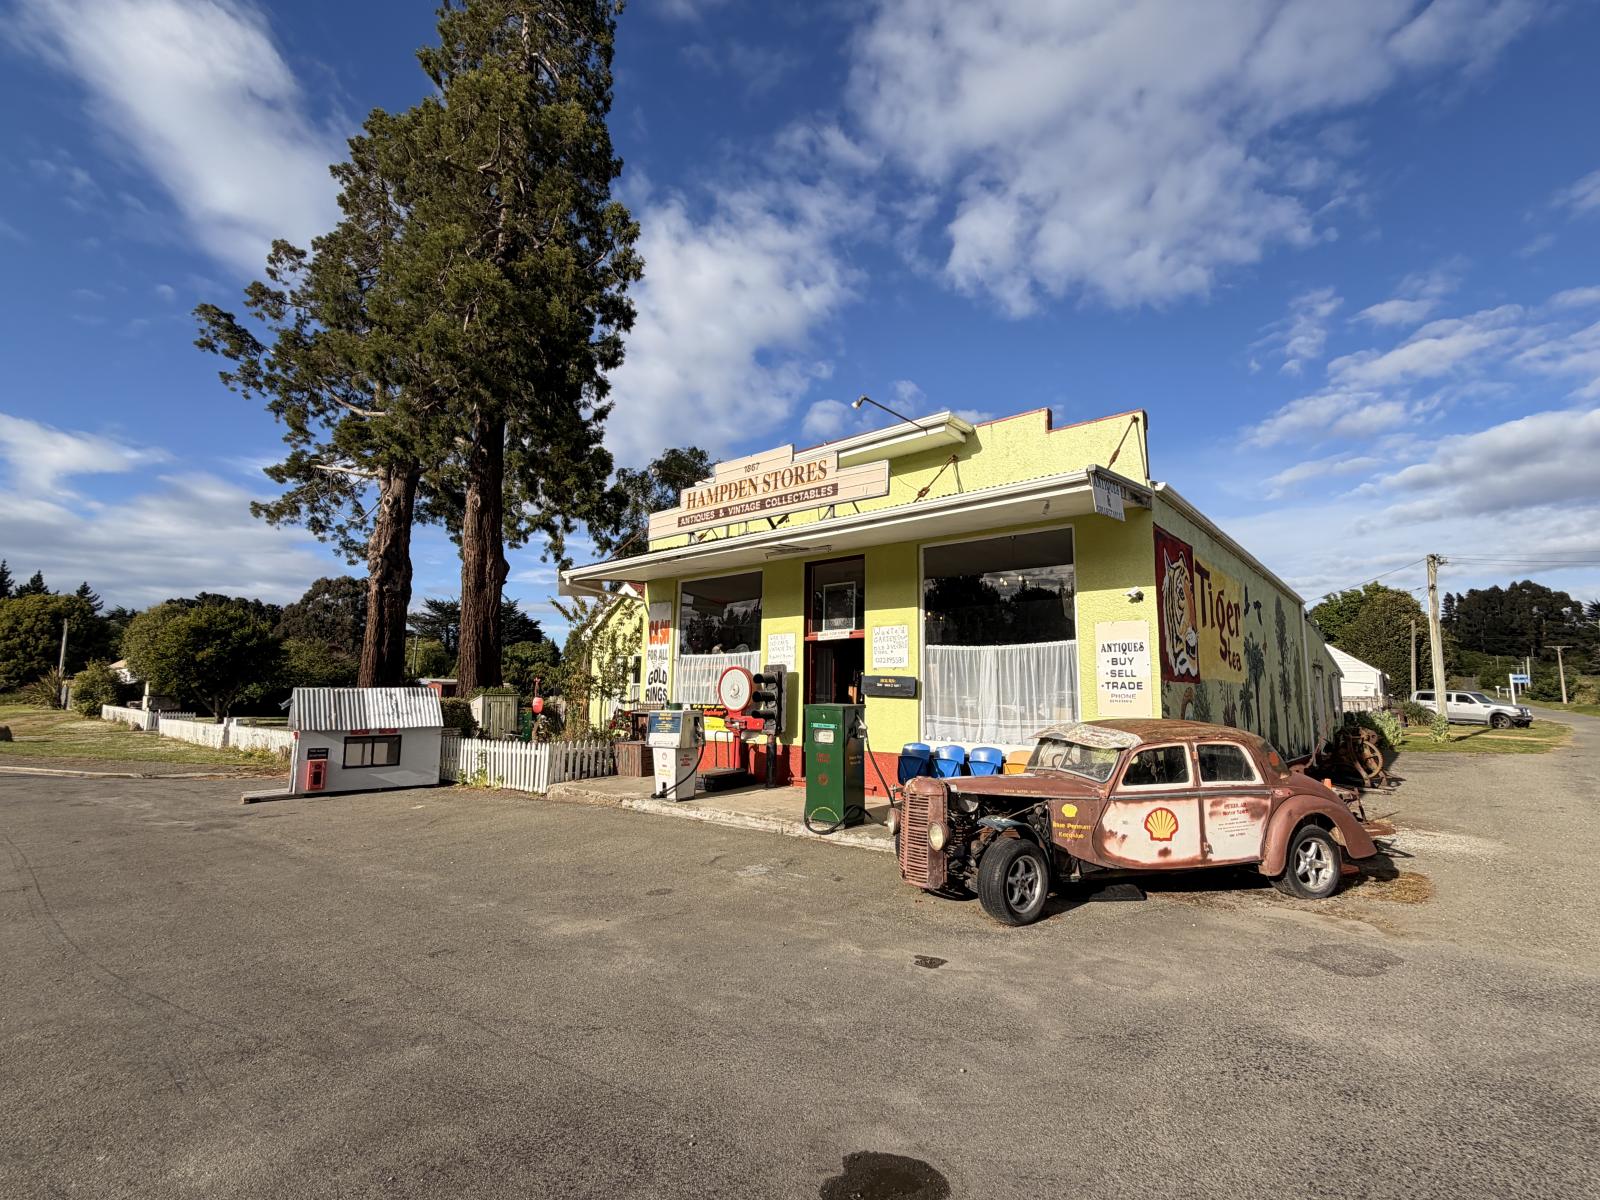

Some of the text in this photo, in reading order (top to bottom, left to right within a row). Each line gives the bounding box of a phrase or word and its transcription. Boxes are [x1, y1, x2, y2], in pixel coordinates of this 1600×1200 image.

[686, 460, 828, 510] HAMPDEN STORES
[680, 486, 834, 526] ANTIQUES & VINTAGE COLLECTABLES
[1195, 559, 1240, 661] Tiger
[648, 648, 668, 661] FOR ALL
[1101, 642, 1145, 655] ANTIQUES
[1111, 657, 1135, 666] BUY
[648, 667, 667, 685] GOLD
[1110, 669, 1137, 678] SELL
[1105, 681, 1143, 690] TRADE
[645, 686, 668, 702] RINGS
